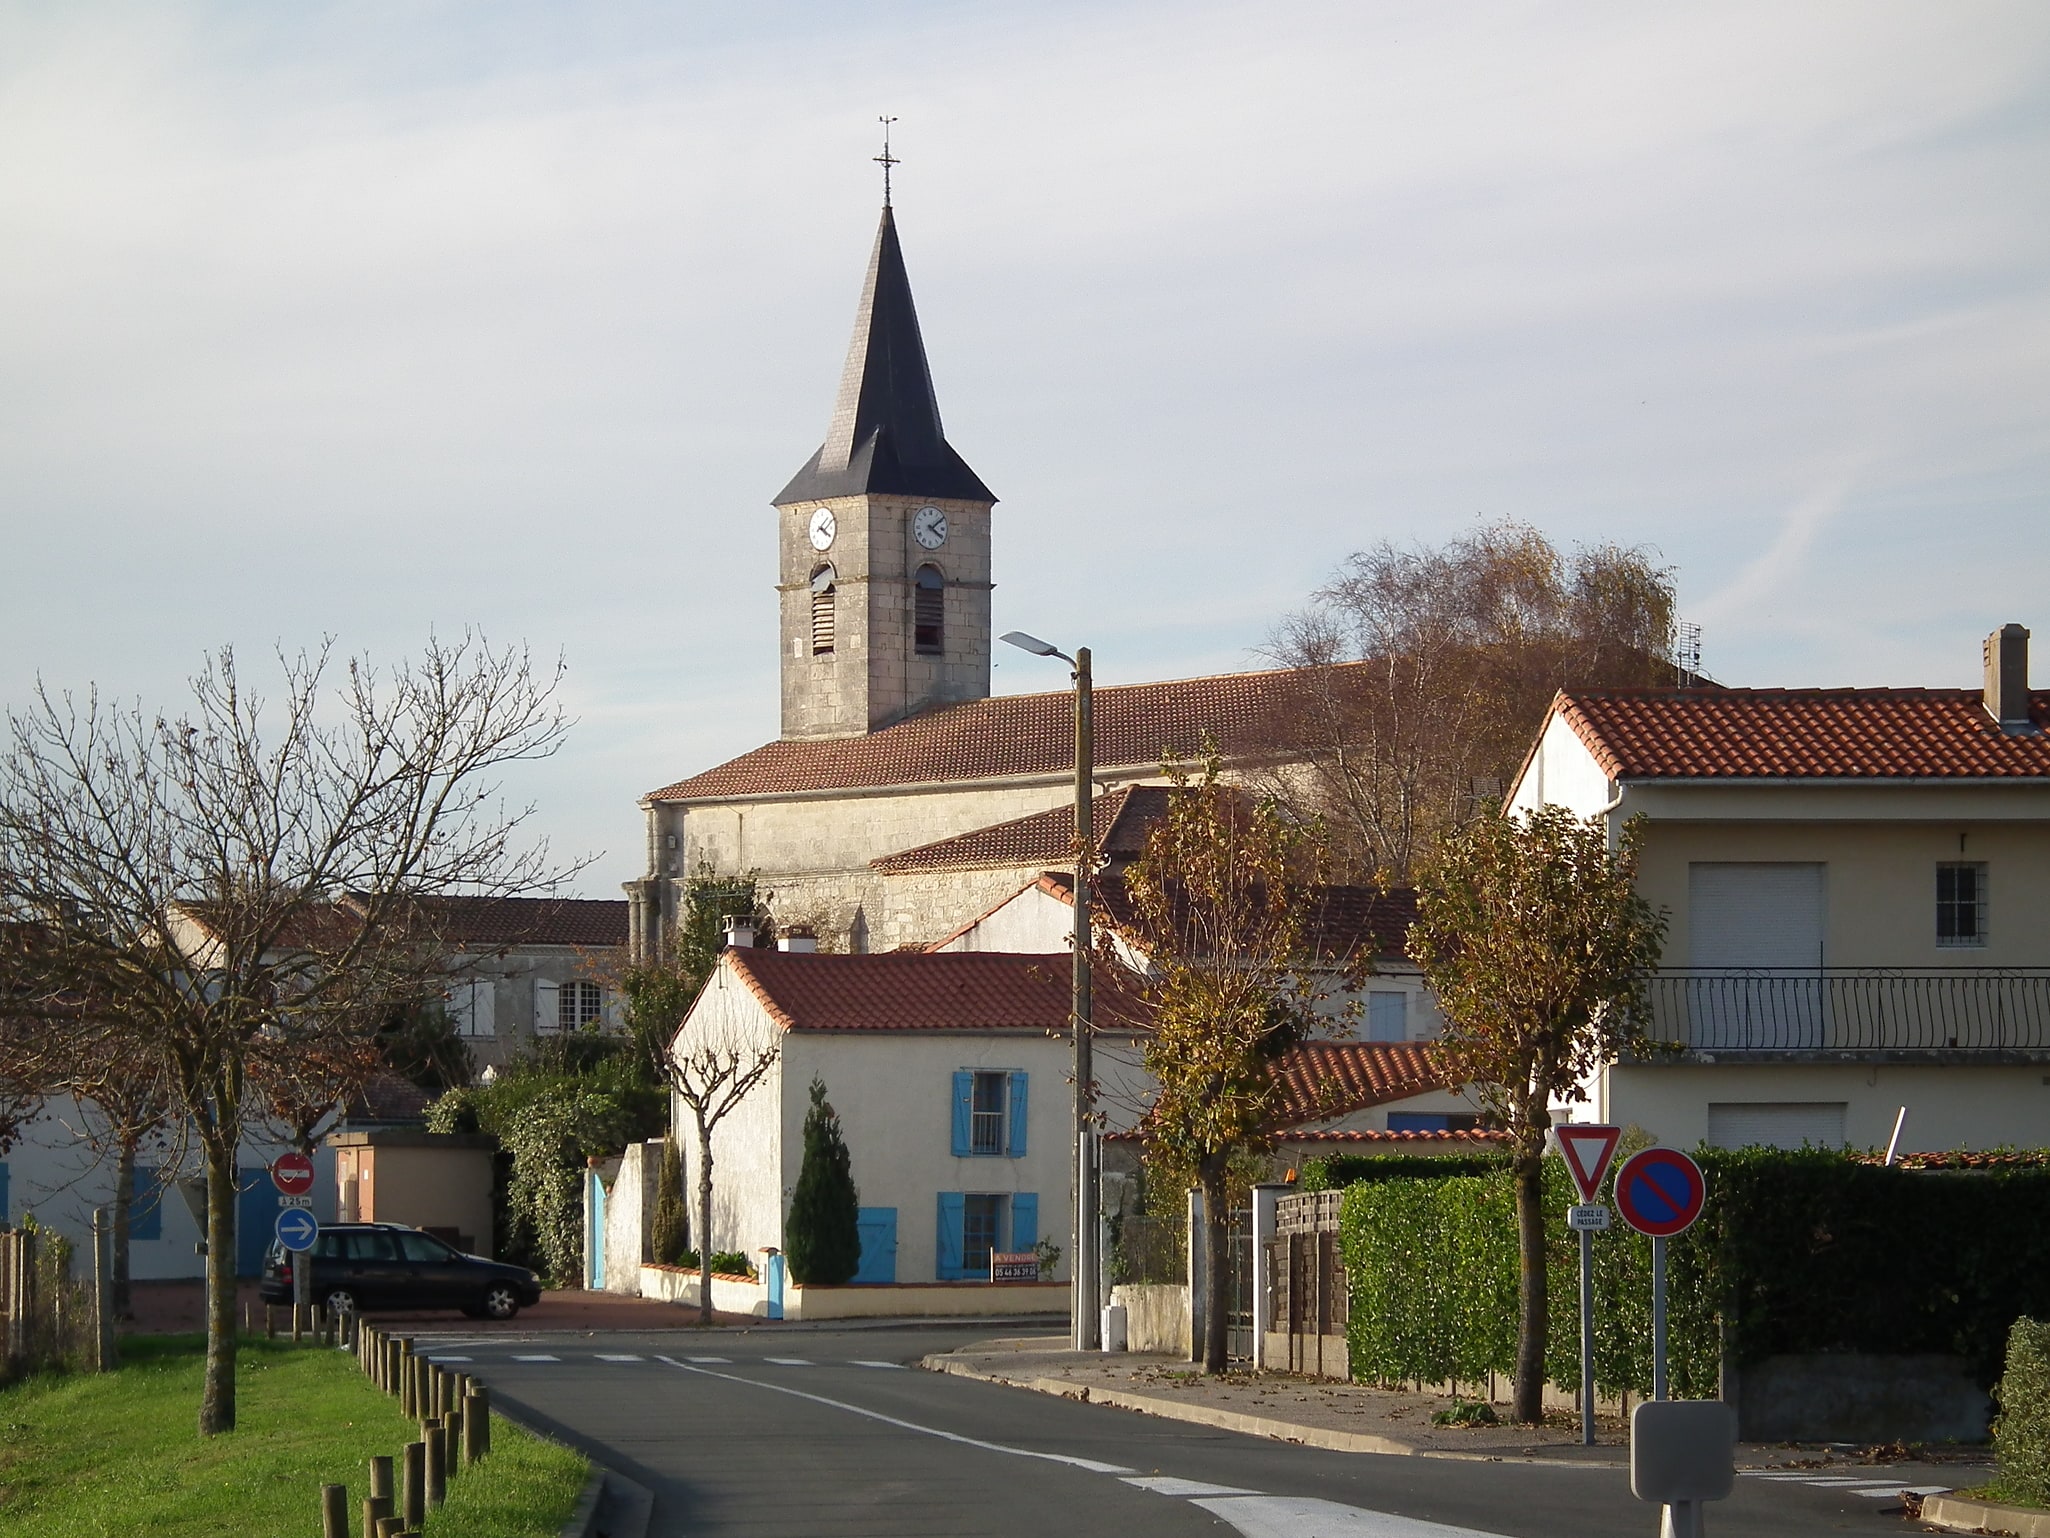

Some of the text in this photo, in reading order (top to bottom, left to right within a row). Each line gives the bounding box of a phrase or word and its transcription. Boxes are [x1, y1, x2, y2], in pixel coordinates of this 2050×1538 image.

[1576, 1209, 1603, 1217] CÉDEZ LE
[1577, 1218, 1603, 1226] PASSAGE
[1003, 1254, 1036, 1262] VENDRE
[995, 1268, 1003, 1277] 05
[1004, 1268, 1012, 1276] 46
